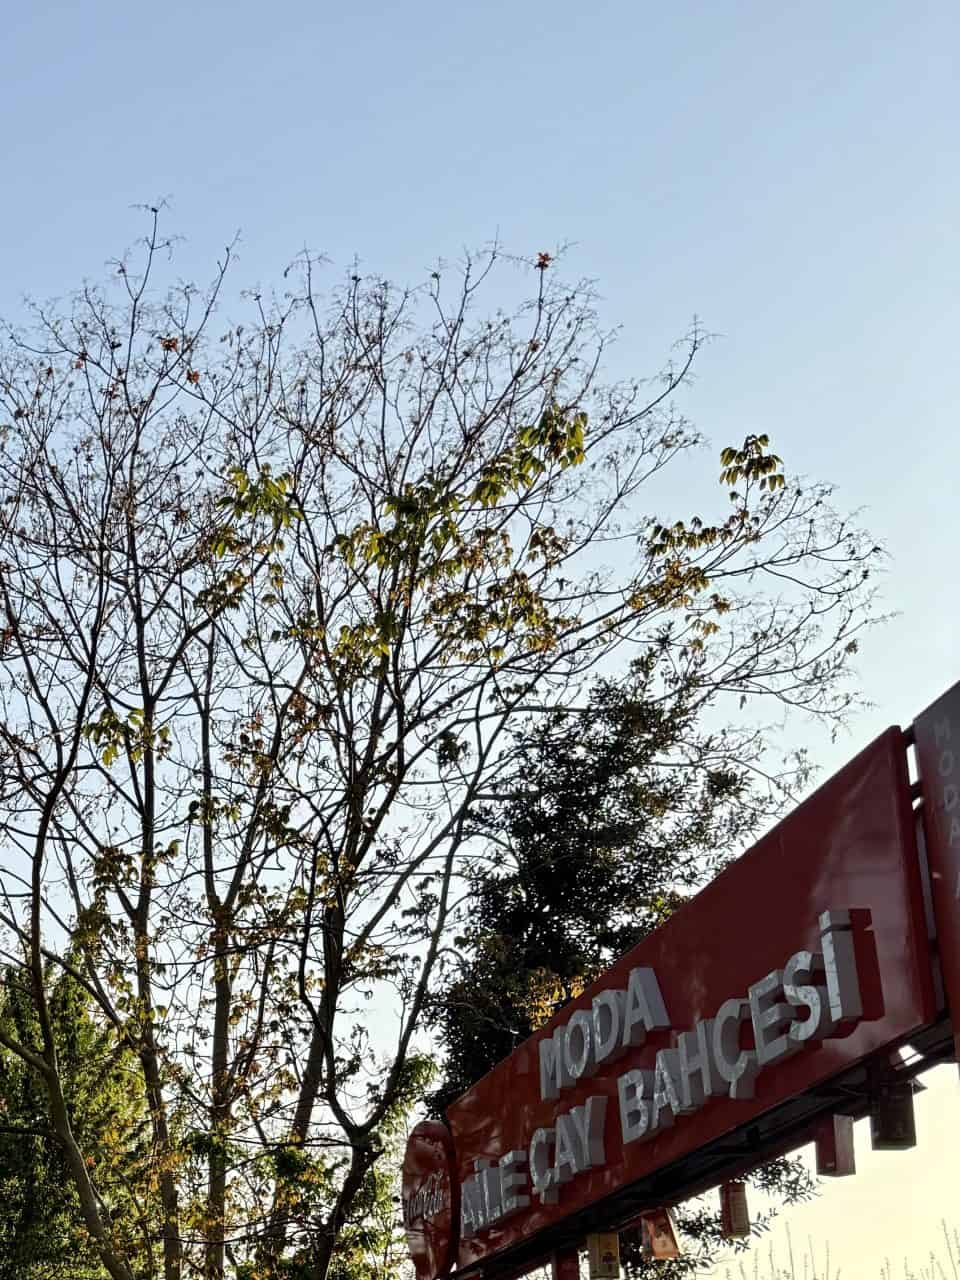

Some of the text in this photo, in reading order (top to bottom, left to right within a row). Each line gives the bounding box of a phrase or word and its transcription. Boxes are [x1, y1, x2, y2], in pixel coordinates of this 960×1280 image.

[530, 1096, 608, 1205] ÇAY
[617, 909, 861, 1144] BAHÇESİ
[539, 967, 671, 1101] MODA
